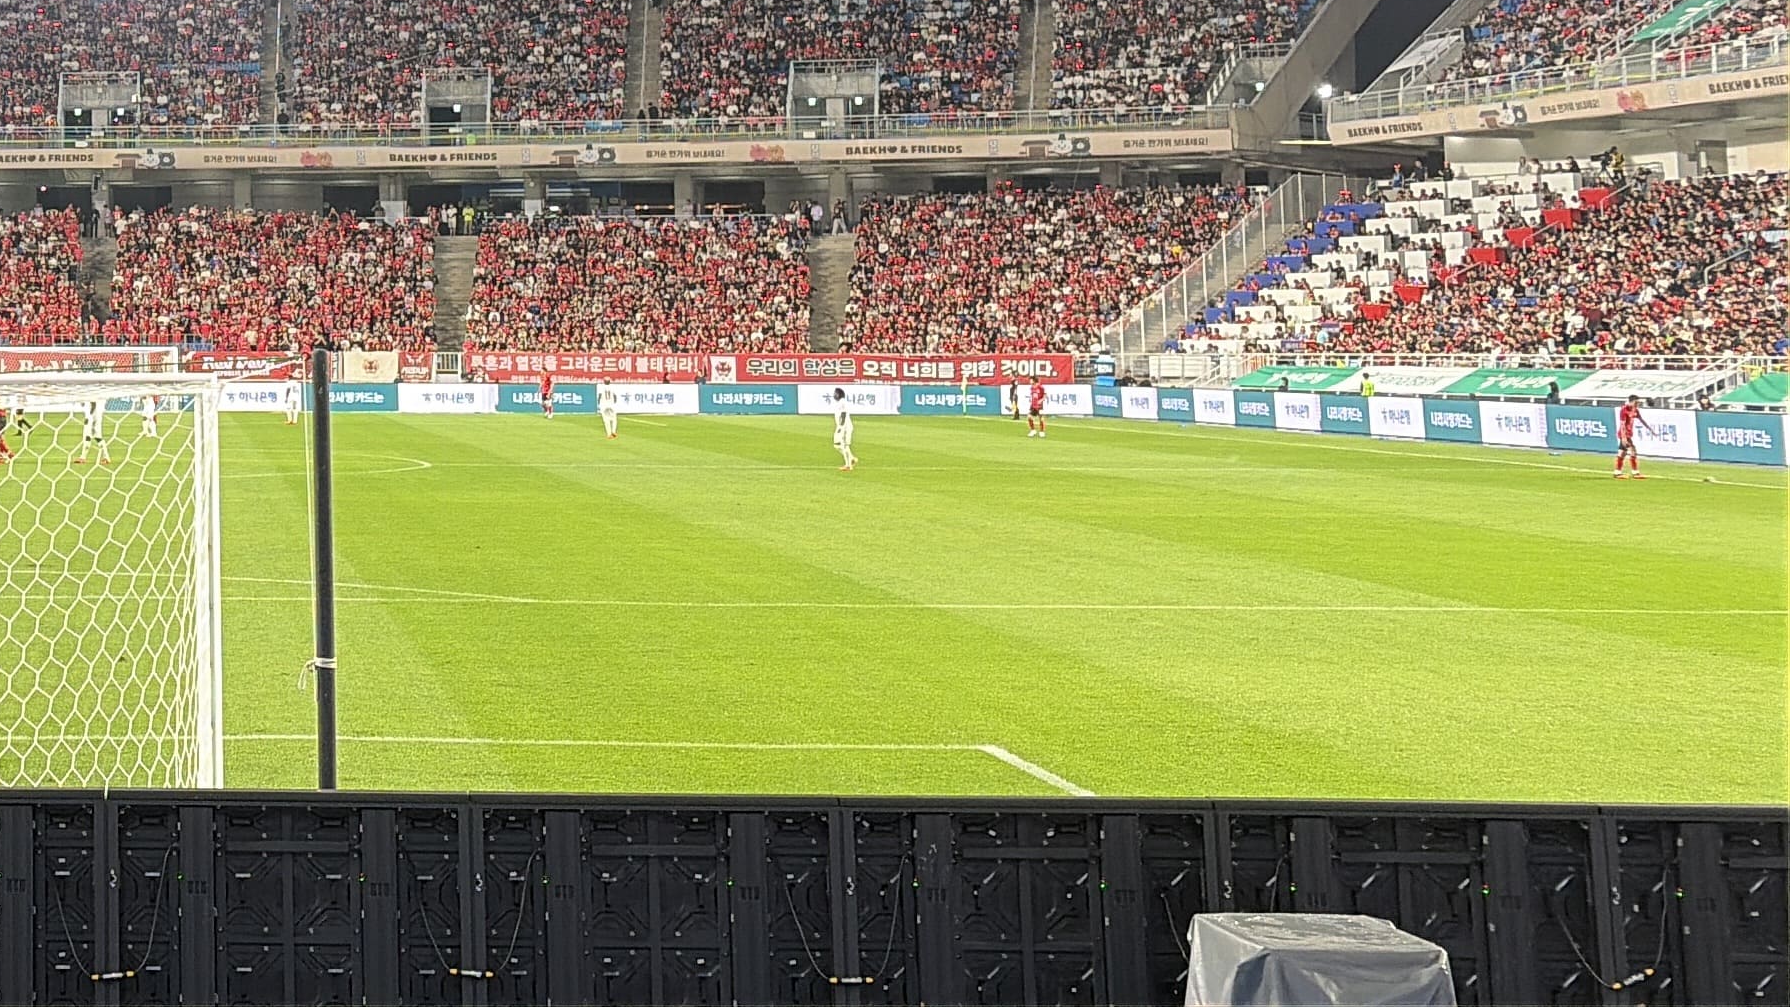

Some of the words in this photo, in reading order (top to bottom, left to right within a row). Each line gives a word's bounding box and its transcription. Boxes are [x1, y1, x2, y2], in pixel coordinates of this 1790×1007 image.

[1754, 78, 1761, 88] &
[900, 145, 908, 154] &
[911, 144, 963, 154] FRIENDS
[39, 154, 46, 163] &
[48, 153, 94, 163] FRIENDS
[440, 153, 447, 162] &
[450, 152, 497, 161] FRIENDS
[515, 355, 558, 372] 열정을
[560, 355, 631, 373] 그라운드에
[747, 358, 798, 376] 우리의
[804, 358, 855, 376] 함성은
[862, 360, 897, 377] 오직
[903, 360, 954, 379] 너희를
[961, 359, 995, 378] 위한
[1001, 359, 1058, 377] 것이다.
[513, 392, 582, 404] 나라사카드는
[847, 394, 876, 405] 나은행
